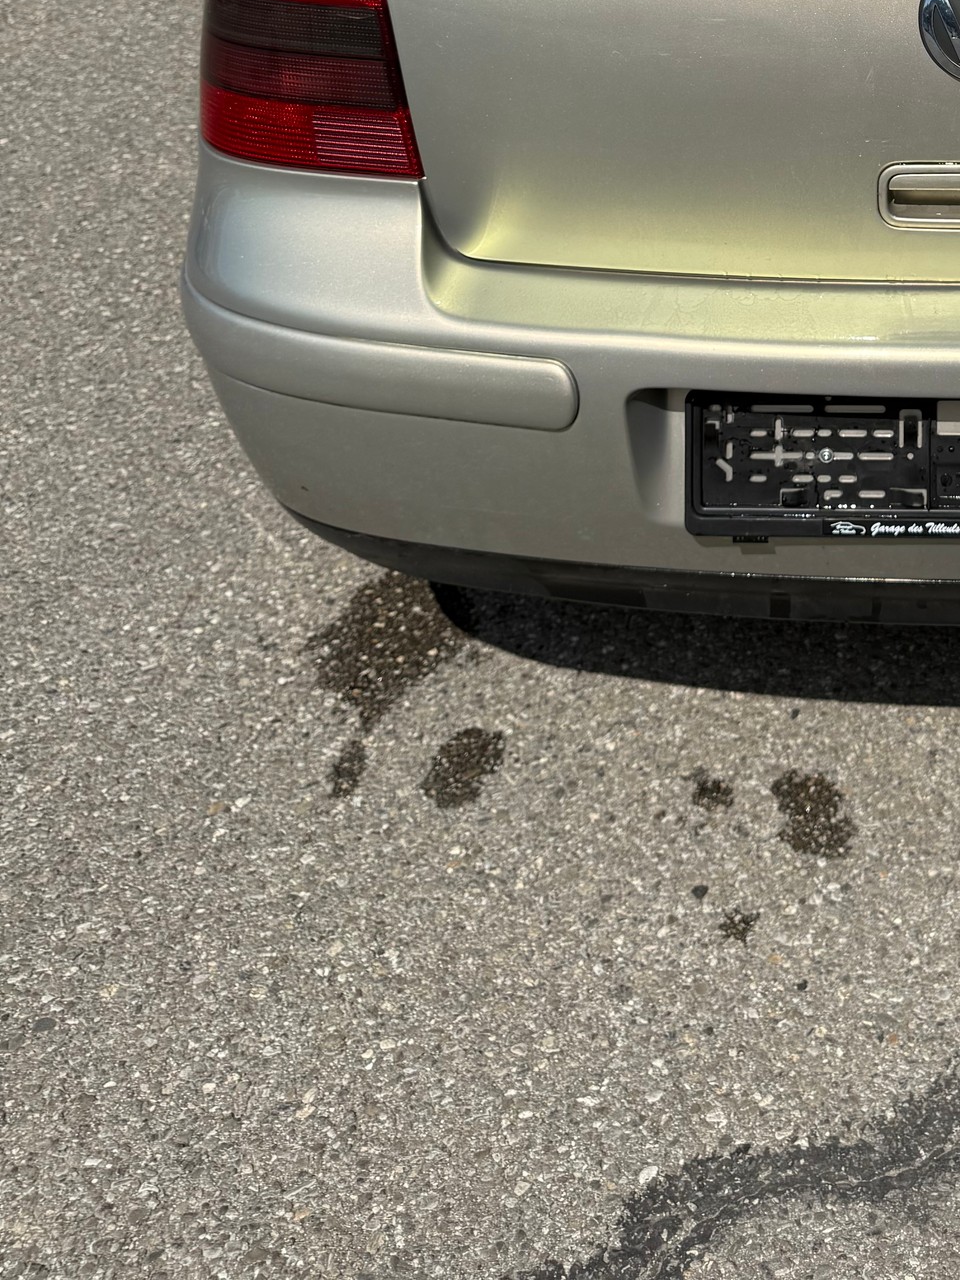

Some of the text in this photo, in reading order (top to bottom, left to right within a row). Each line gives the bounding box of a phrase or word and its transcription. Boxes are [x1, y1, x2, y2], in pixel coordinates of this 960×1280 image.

[870, 522, 905, 536] Garage
[908, 523, 923, 533] des
[925, 522, 960, 534] Tilleuls
